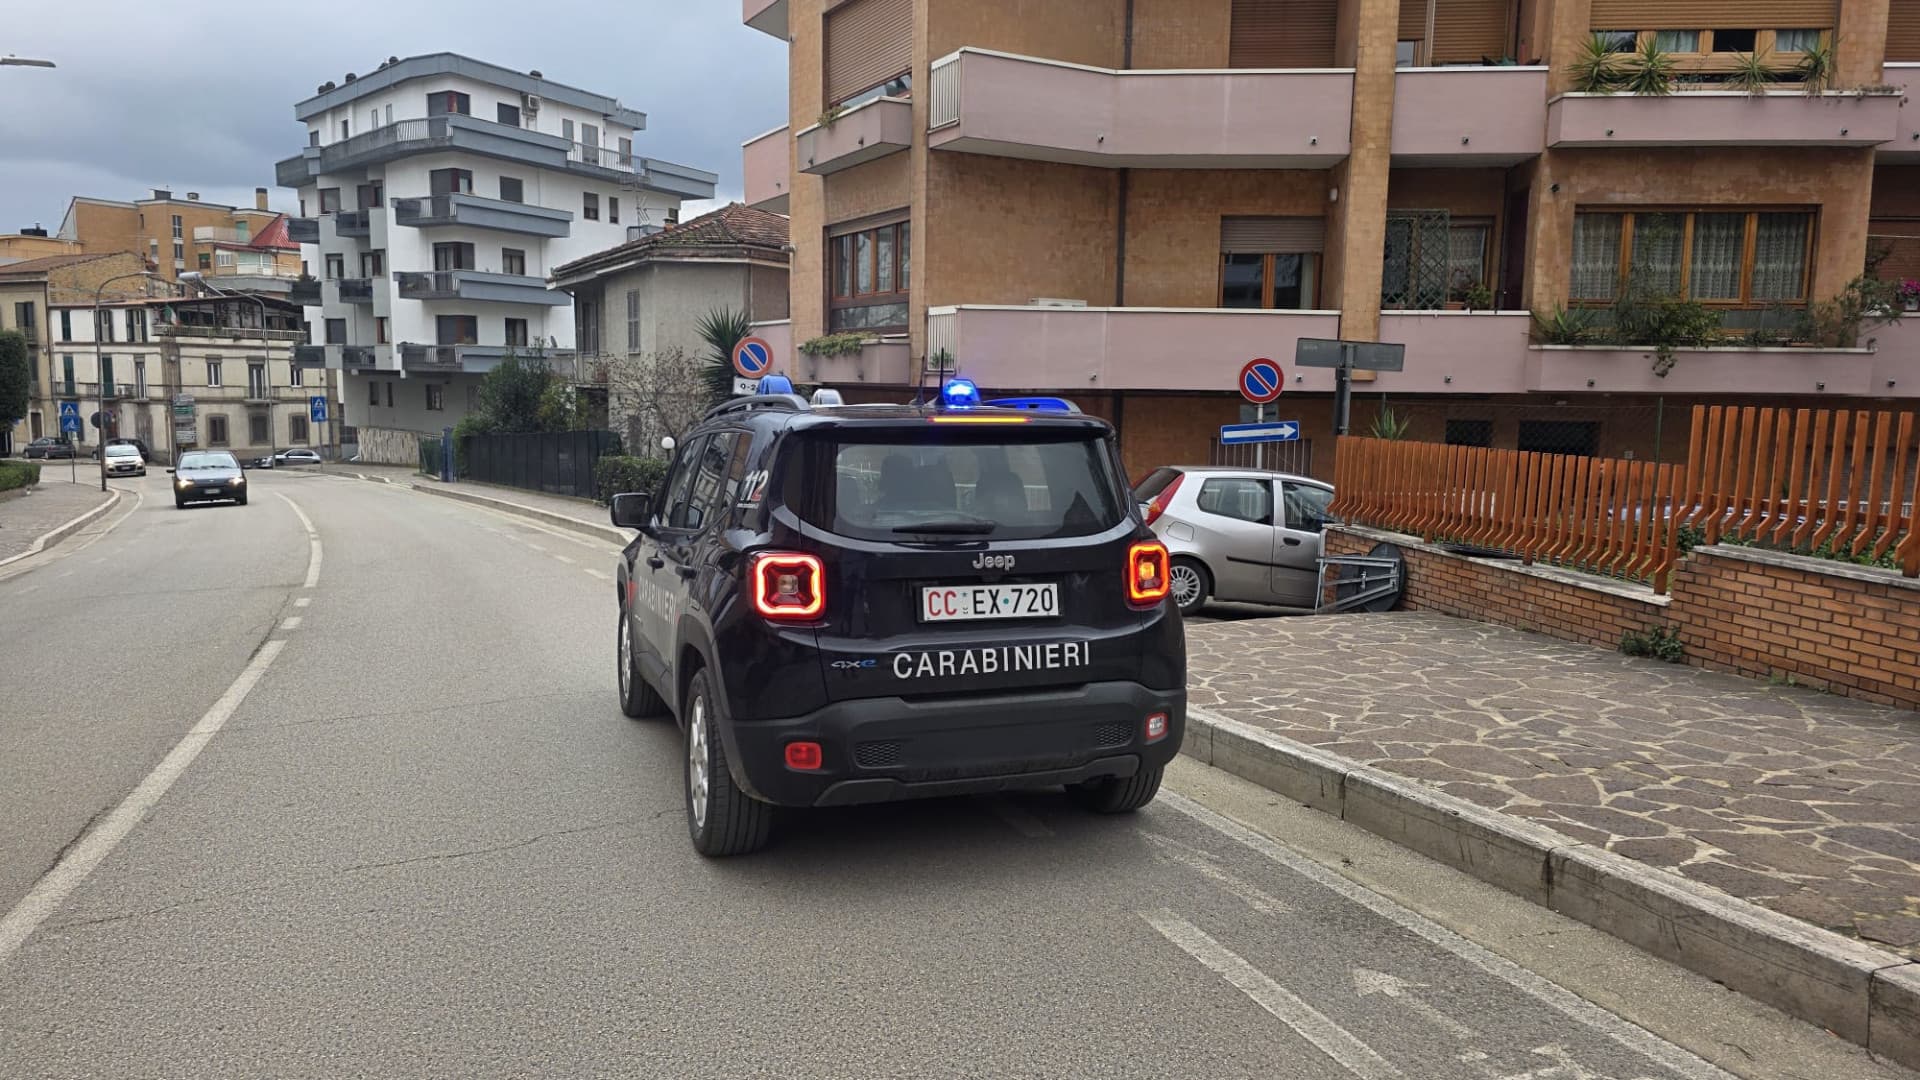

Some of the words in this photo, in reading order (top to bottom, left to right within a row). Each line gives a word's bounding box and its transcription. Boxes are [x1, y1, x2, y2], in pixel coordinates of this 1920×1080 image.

[740, 469, 769, 502] 112
[972, 553, 1015, 571] Jeep
[928, 591, 958, 617] CC
[1011, 587, 1053, 613] 720
[893, 641, 1090, 679] CARABINIERI
